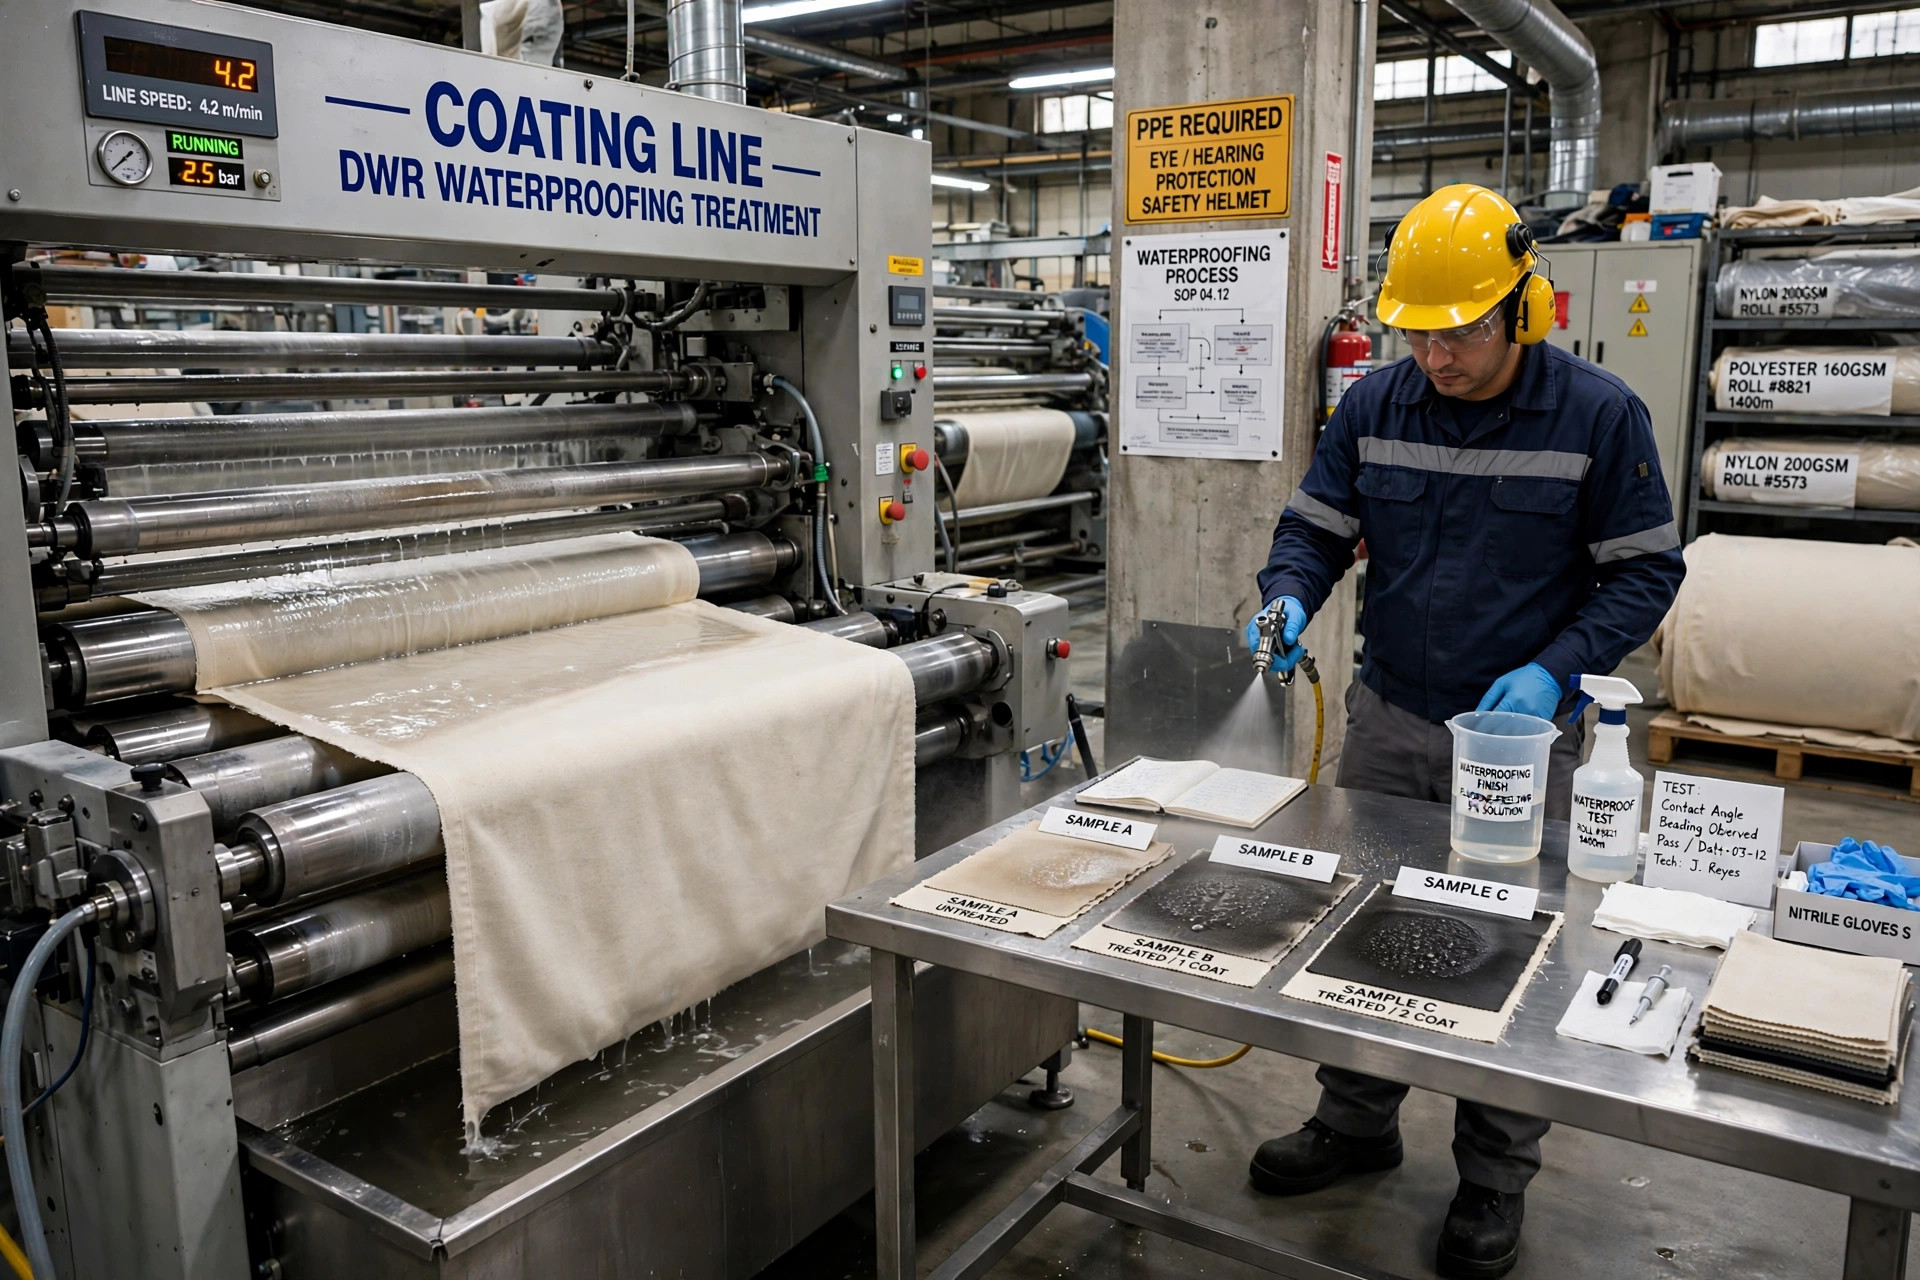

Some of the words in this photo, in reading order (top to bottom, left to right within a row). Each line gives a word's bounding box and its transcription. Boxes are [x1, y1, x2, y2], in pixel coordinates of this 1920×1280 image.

[214, 60, 255, 91] 4.2
[102, 84, 136, 105] LINE
[140, 90, 192, 112] SPEED:
[200, 98, 219, 116] 4.2
[222, 104, 263, 121] m/min
[425, 81, 656, 173] COATING
[672, 122, 763, 188] LINE
[1137, 116, 1173, 140] PPE
[1180, 106, 1283, 137] REQUIRED
[172, 133, 239, 157] RUNNING
[1150, 150, 1178, 169] EYE
[1183, 149, 1189, 167] /
[1193, 143, 1264, 166] HEARING
[181, 160, 215, 184] 2.5
[218, 170, 240, 186] bar
[1156, 167, 1256, 191] PROTECTION
[339, 149, 425, 199] DWR
[434, 161, 684, 225] WATERPROOFING
[691, 193, 821, 237] TREATMENT
[1142, 194, 1201, 214] SAFETY
[1206, 189, 1271, 211] HELMET
[1137, 245, 1271, 265] WATERPROOFING
[1166, 267, 1239, 284] PROCESS
[1174, 288, 1197, 301] SOP
[1200, 288, 1230, 301] 04.12
[1740, 287, 1777, 300] NYLON
[1782, 286, 1828, 300] 200GSM
[1740, 303, 1774, 315] ROLL
[1779, 303, 1819, 315] #5573
[1729, 361, 1817, 376] POLYESTER
[1823, 362, 1887, 377] 160GSM
[1728, 380, 1764, 393] ROLL
[1769, 381, 1811, 393] #8821
[1729, 396, 1774, 409] 1400m
[1725, 455, 1778, 471] NYLON
[1784, 457, 1849, 473] 200GSM
[1723, 473, 1760, 487] ROLL
[1764, 474, 1808, 489] #5573
[1460, 762, 1531, 780] WATERPROOFING
[1663, 781, 1700, 795] TEST:
[1574, 793, 1636, 812] WATERPROOF
[1661, 799, 1705, 815] Contact
[1711, 805, 1743, 823] Angle
[1065, 813, 1120, 834] SAMPLE
[1121, 824, 1133, 836] A
[1587, 811, 1615, 824] TEST
[1659, 816, 1702, 837] Beading
[1238, 843, 1299, 864] SAMPLE
[1302, 854, 1314, 866] B
[1657, 834, 1679, 848] Pass
[1684, 838, 1694, 853] /
[1654, 853, 1682, 867] Tech:
[1690, 859, 1702, 872] J.
[1709, 862, 1740, 881] Reyes
[1424, 876, 1492, 899] SAMPLE
[1497, 888, 1509, 901] C
[935, 903, 1009, 926] UNTREATED
[947, 896, 1001, 916] SAMPLE
[1003, 909, 1018, 918] A
[1789, 906, 1840, 927] NITRILE
[1843, 916, 1898, 937] GLOVES
[1902, 926, 1911, 939] S
[1106, 942, 1167, 963] TREATED
[1188, 961, 1229, 977] COAT
[1133, 938, 1196, 960] SAMPLE
[1201, 953, 1215, 962] B
[1317, 989, 1386, 1013] TREATED
[1414, 1012, 1459, 1029] COAT
[1342, 985, 1418, 1009] SAMPLE
[1424, 1002, 1438, 1013] C
